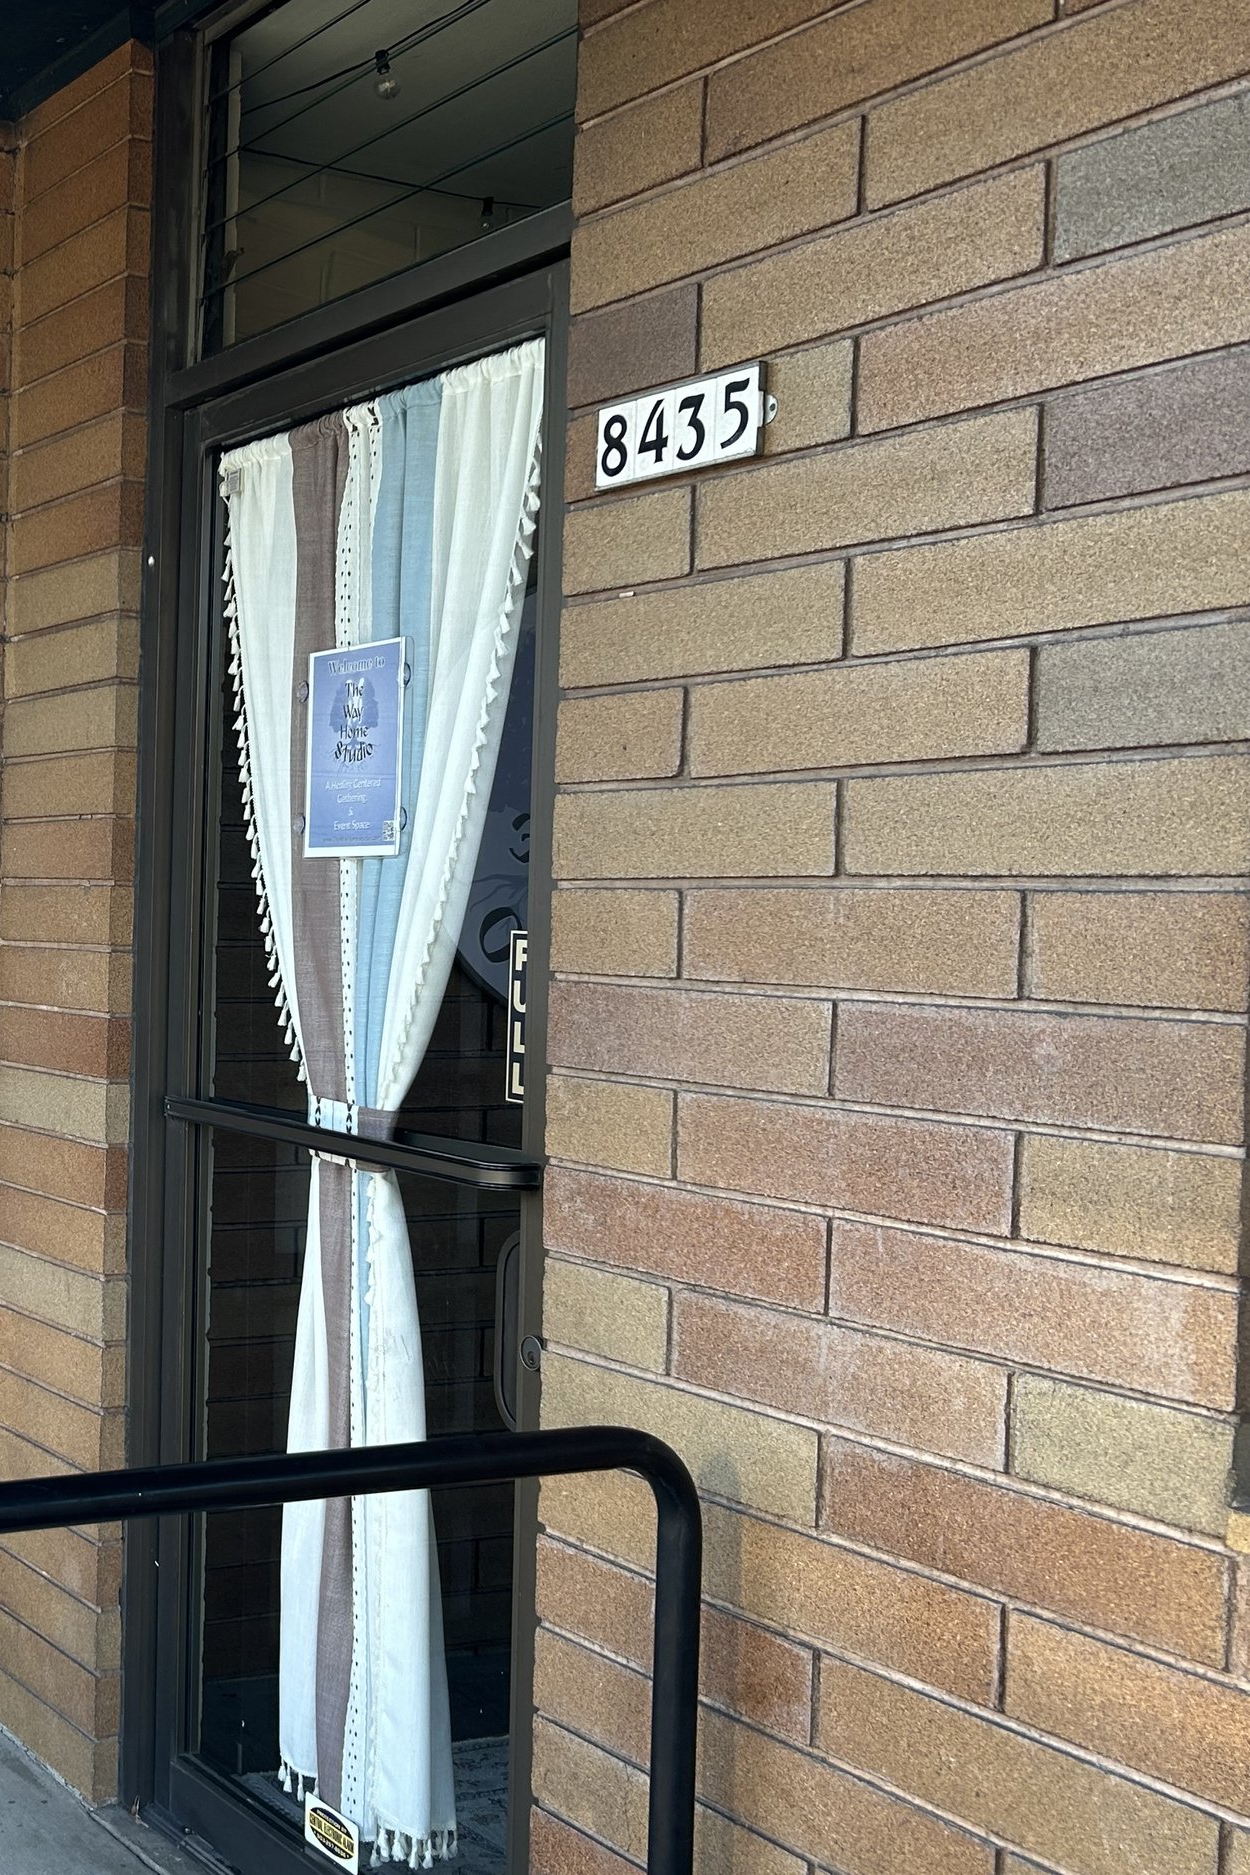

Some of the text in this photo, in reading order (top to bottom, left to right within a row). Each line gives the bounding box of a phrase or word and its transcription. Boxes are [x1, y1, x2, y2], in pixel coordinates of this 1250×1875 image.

[601, 377, 750, 478] 8435
[328, 655, 385, 676] Welcome to
[344, 681, 364, 697] The
[342, 703, 364, 721] Way
[339, 724, 369, 741] Home
[334, 740, 374, 764] Studio
[333, 819, 371, 831] Event Space
